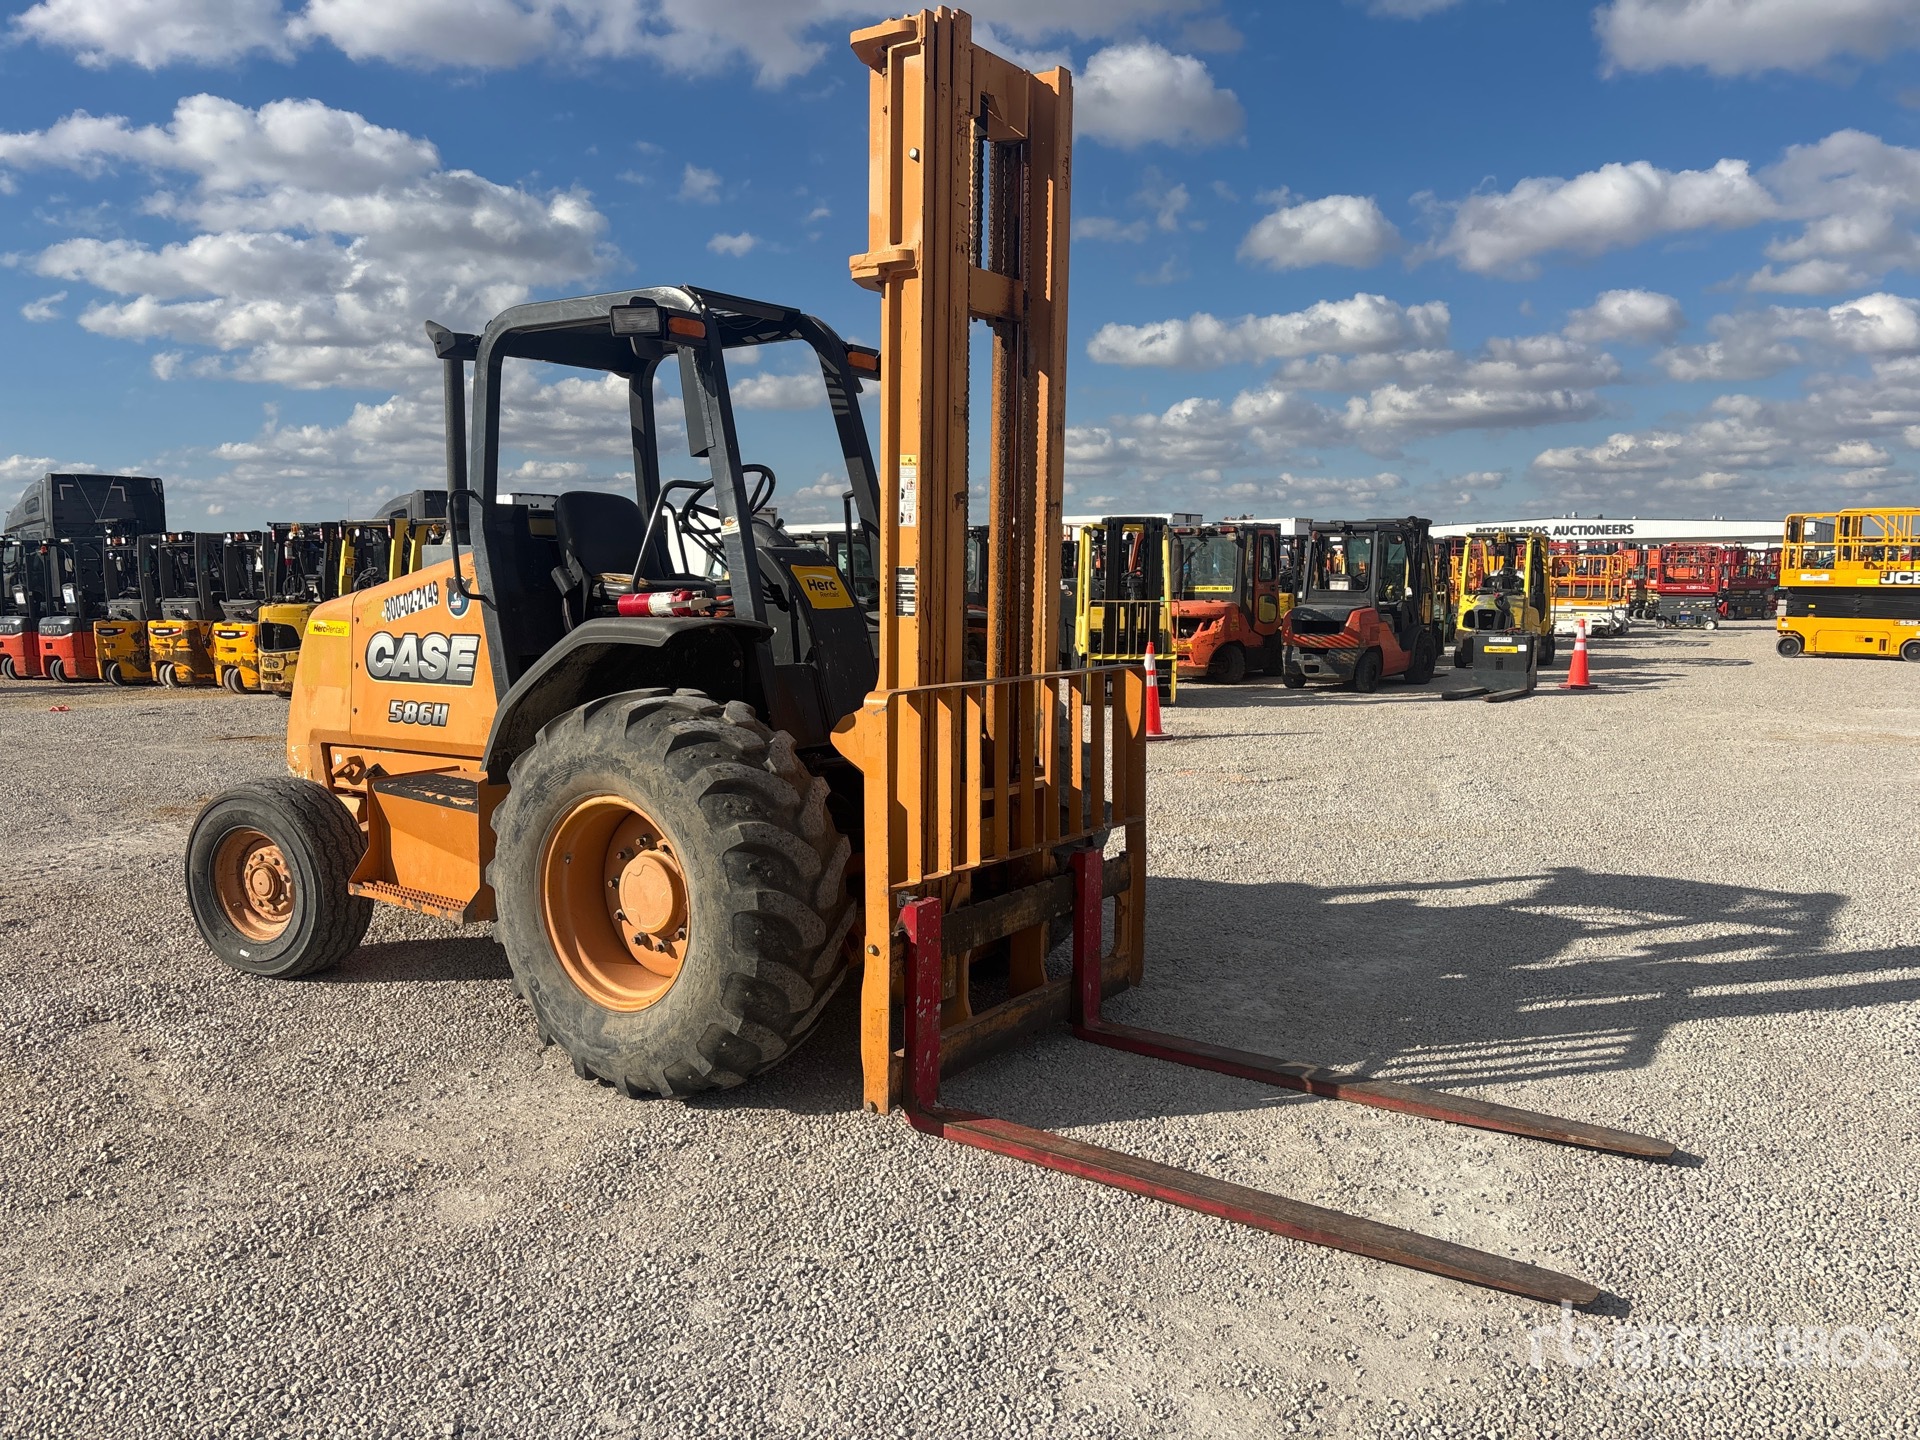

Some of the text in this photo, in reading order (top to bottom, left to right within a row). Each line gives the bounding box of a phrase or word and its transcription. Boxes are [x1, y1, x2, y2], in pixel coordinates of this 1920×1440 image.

[1553, 524, 1634, 536] AUCTIONEERS
[806, 579, 837, 592] Herc
[384, 580, 439, 622] 800-02-2149
[366, 631, 481, 683] CASE
[389, 700, 450, 727] 586H
